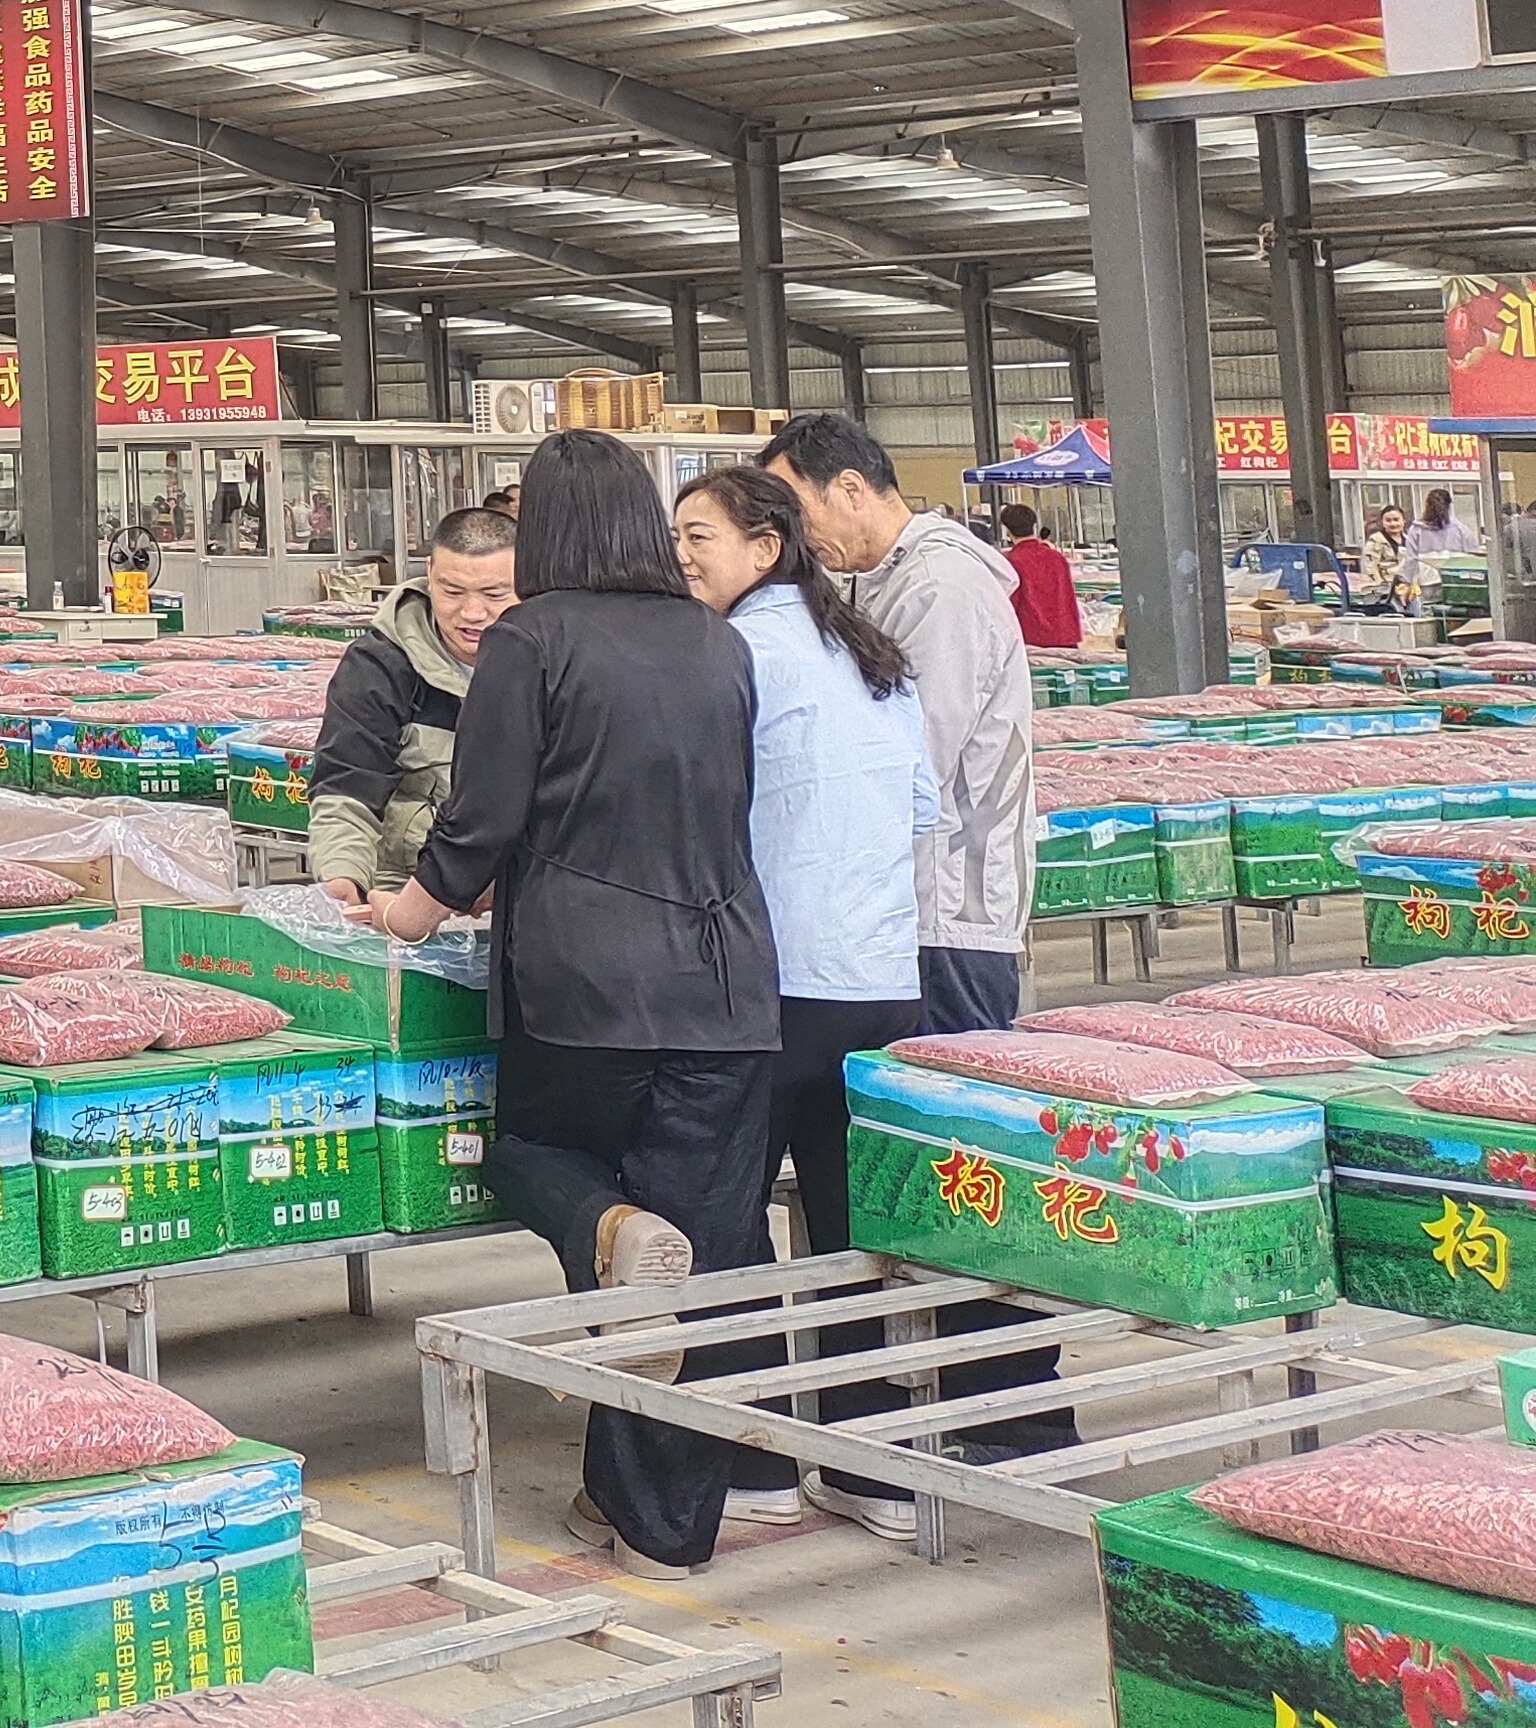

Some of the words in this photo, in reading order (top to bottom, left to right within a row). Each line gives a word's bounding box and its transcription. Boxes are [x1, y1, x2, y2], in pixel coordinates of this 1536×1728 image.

[180, 406, 267, 421] 13931955948
[1399, 883, 1530, 941] 枸杞
[931, 1136, 1120, 1245] 枸杞
[1420, 1193, 1508, 1292] 枸
[115, 1514, 162, 1536] 版权所有
[185, 1577, 210, 1691] 安药果擅
[220, 1570, 244, 1686] 月杞园树树
